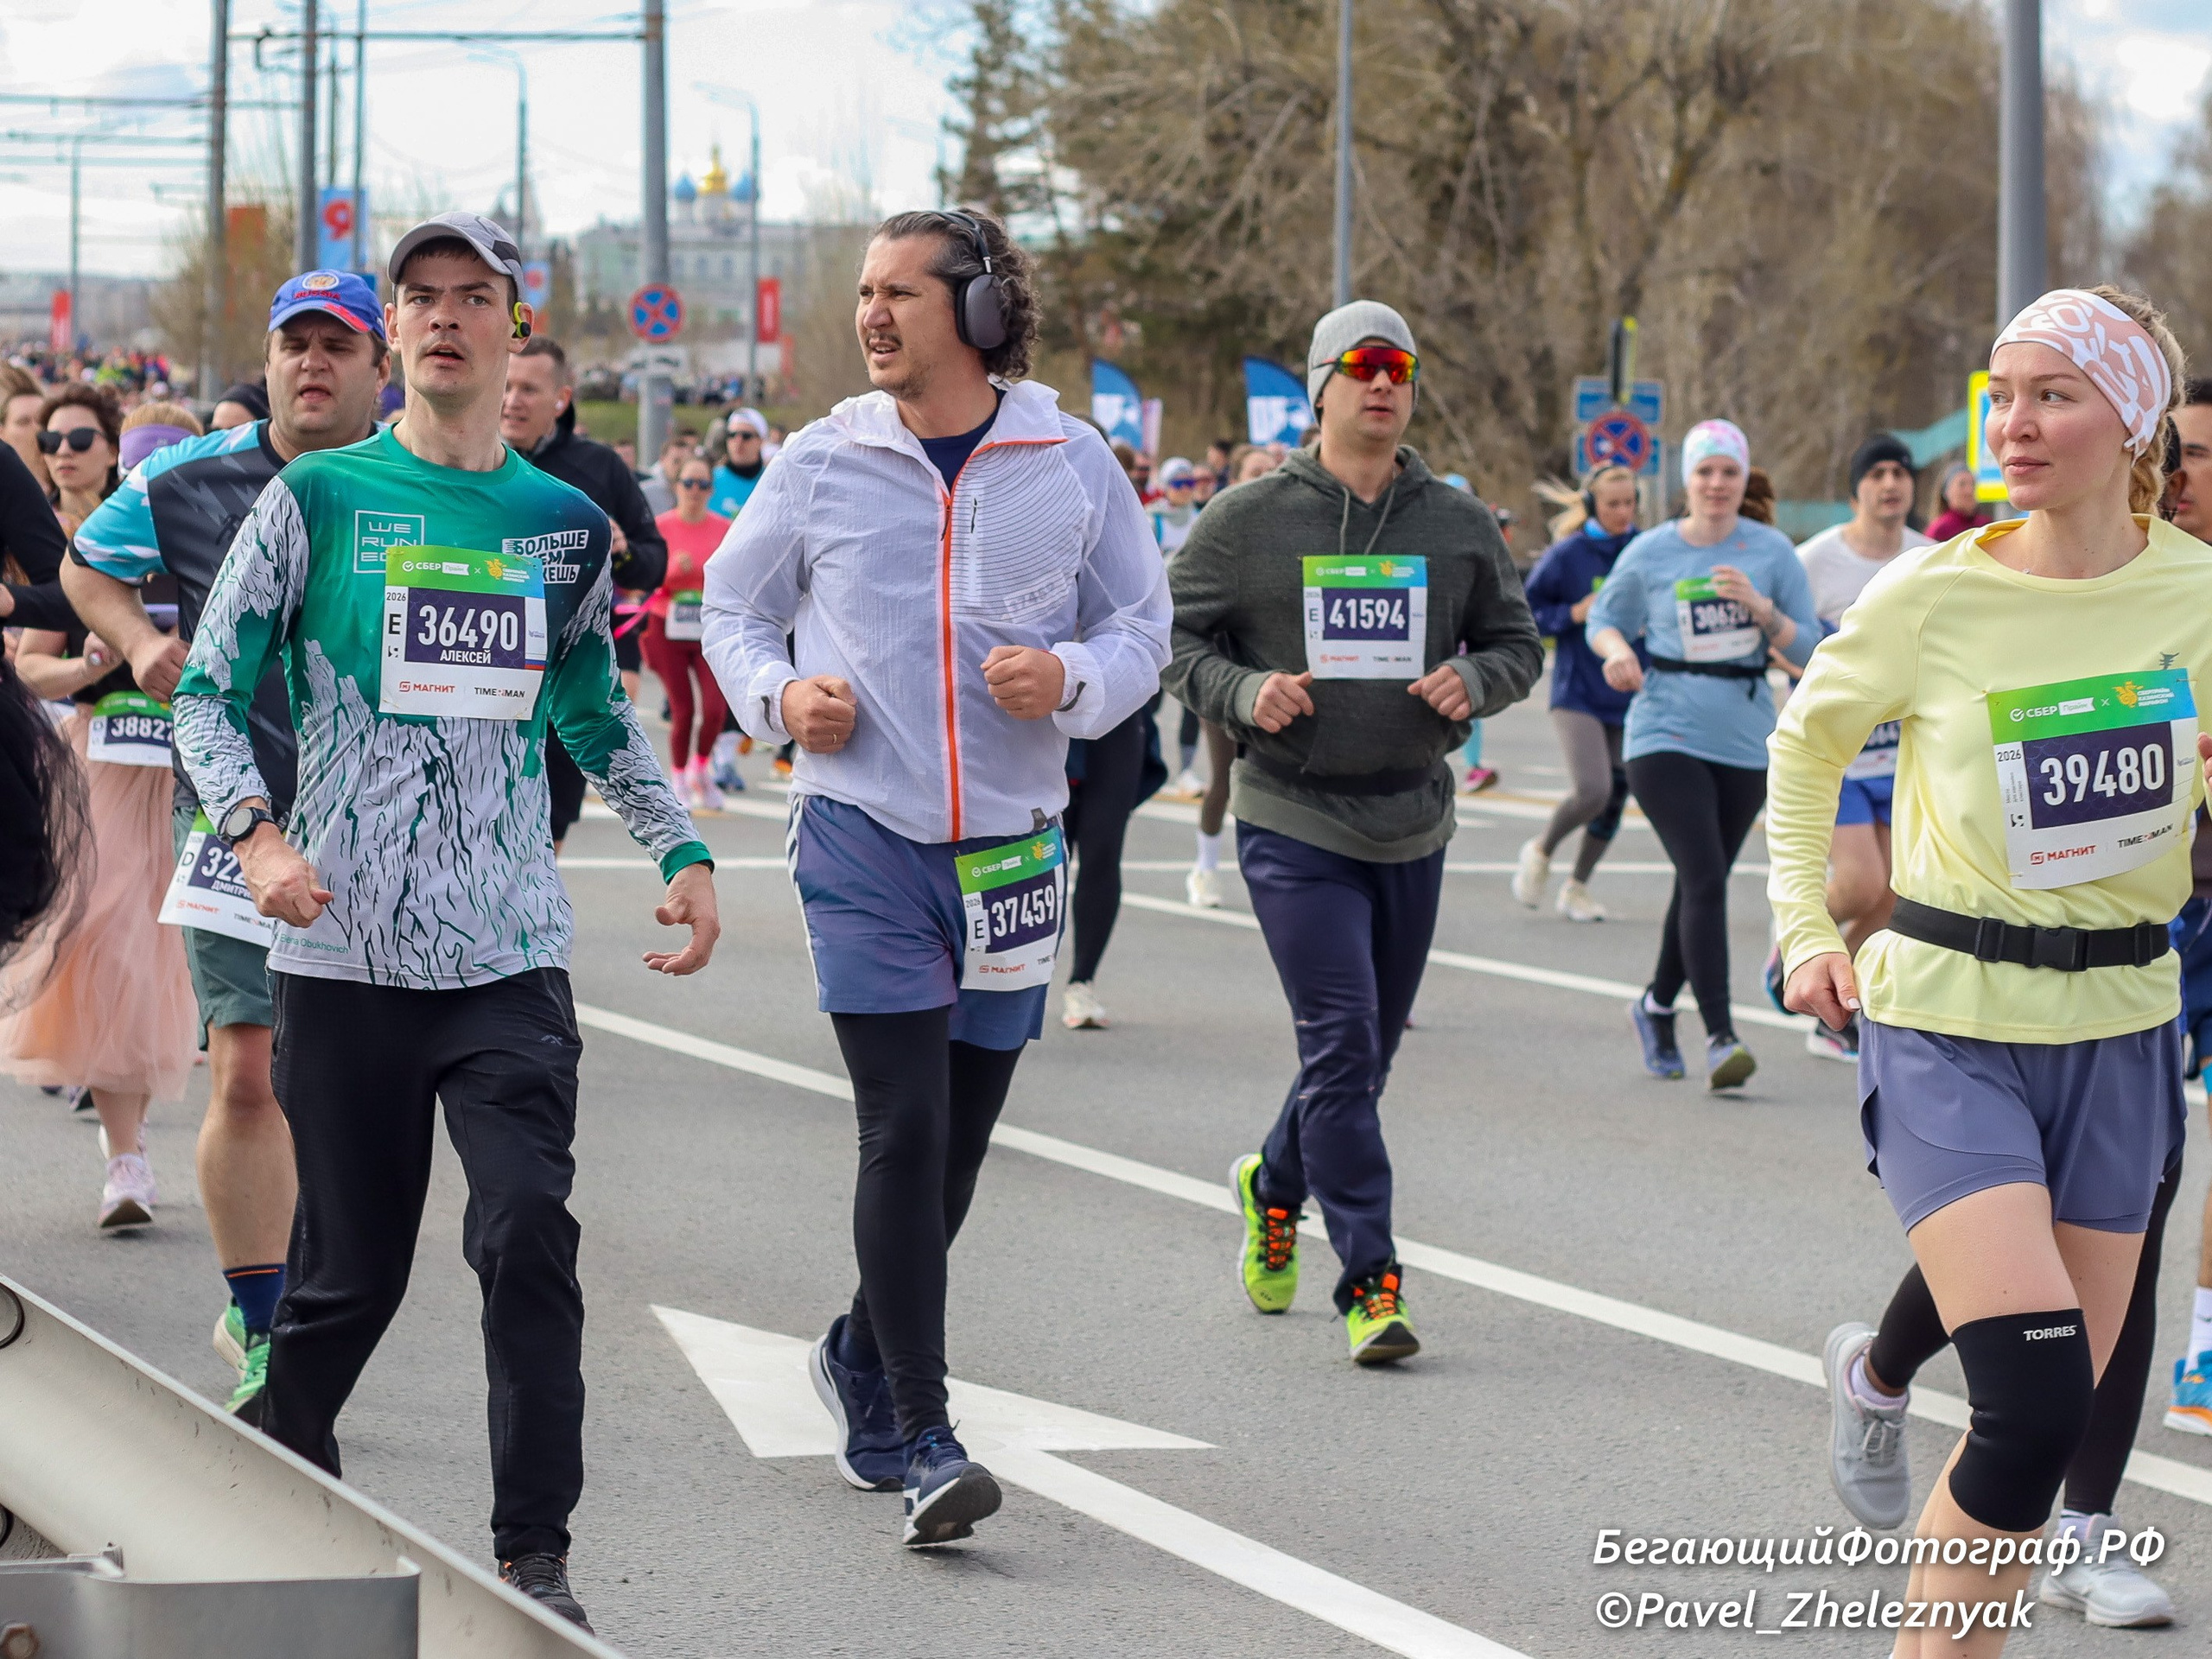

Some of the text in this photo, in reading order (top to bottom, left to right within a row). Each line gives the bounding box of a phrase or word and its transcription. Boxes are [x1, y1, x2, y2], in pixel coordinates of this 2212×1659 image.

[368, 521, 411, 534] WE
[361, 537, 417, 547] RUN
[510, 531, 588, 556] БОЛЬШЕ
[533, 550, 563, 566] ЕМ
[416, 562, 442, 571] СБЕР
[386, 592, 407, 601] 2026
[1309, 607, 1319, 622] E
[1329, 598, 1406, 629] 41594
[389, 613, 402, 635] E
[417, 605, 518, 652] 36490
[439, 649, 493, 664] АЛЕКСЕЙ
[413, 683, 456, 694] МАГНИТ
[2025, 705, 2058, 718] СБЕР
[1997, 749, 2022, 762] 2026
[2039, 743, 2166, 805] 39480
[181, 851, 195, 868] D
[2047, 844, 2097, 861] МАГНИТ
[991, 884, 1055, 937] 37459
[974, 918, 985, 940] E
[2023, 1325, 2077, 1342] TORRES
